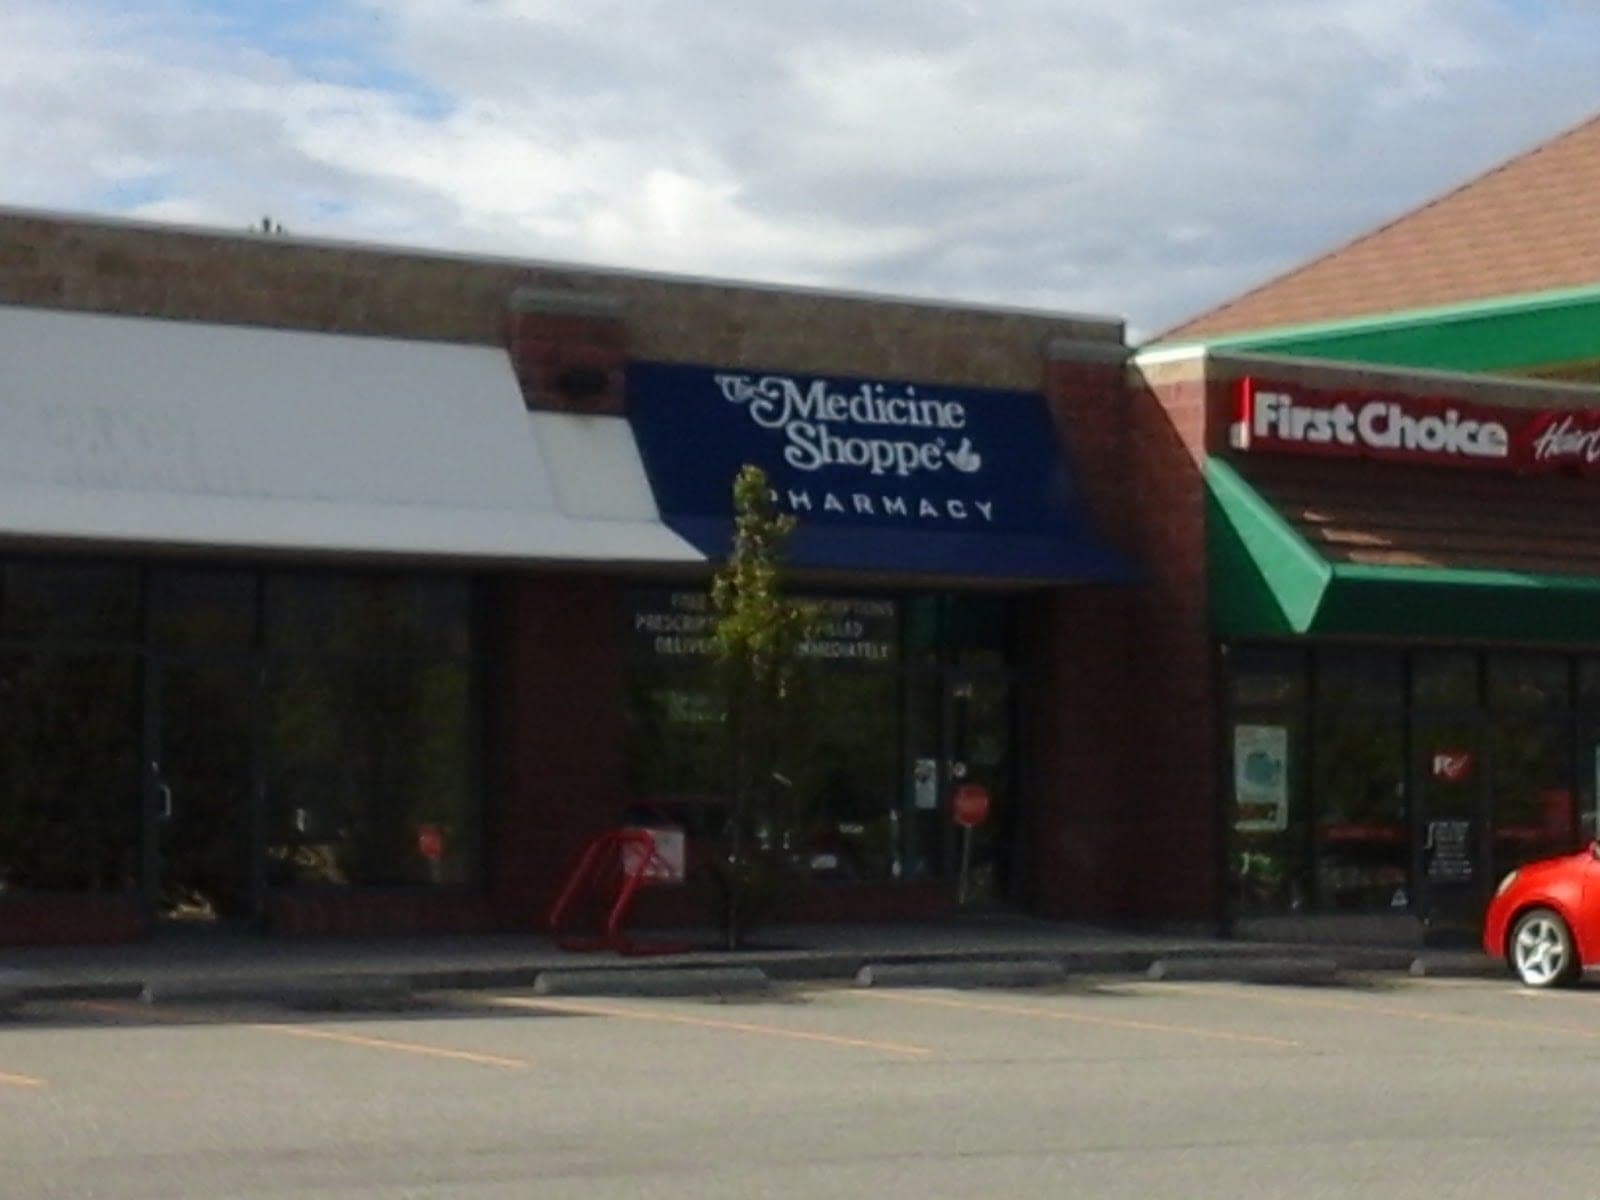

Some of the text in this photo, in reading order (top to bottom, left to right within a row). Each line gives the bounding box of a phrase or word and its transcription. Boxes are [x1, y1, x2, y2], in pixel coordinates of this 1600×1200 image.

[749, 376, 966, 429] Medicine
[1254, 390, 1355, 444] First
[1357, 401, 1509, 458] Choice
[784, 420, 943, 477] Shoppe
[771, 489, 993, 521] HARMACY
